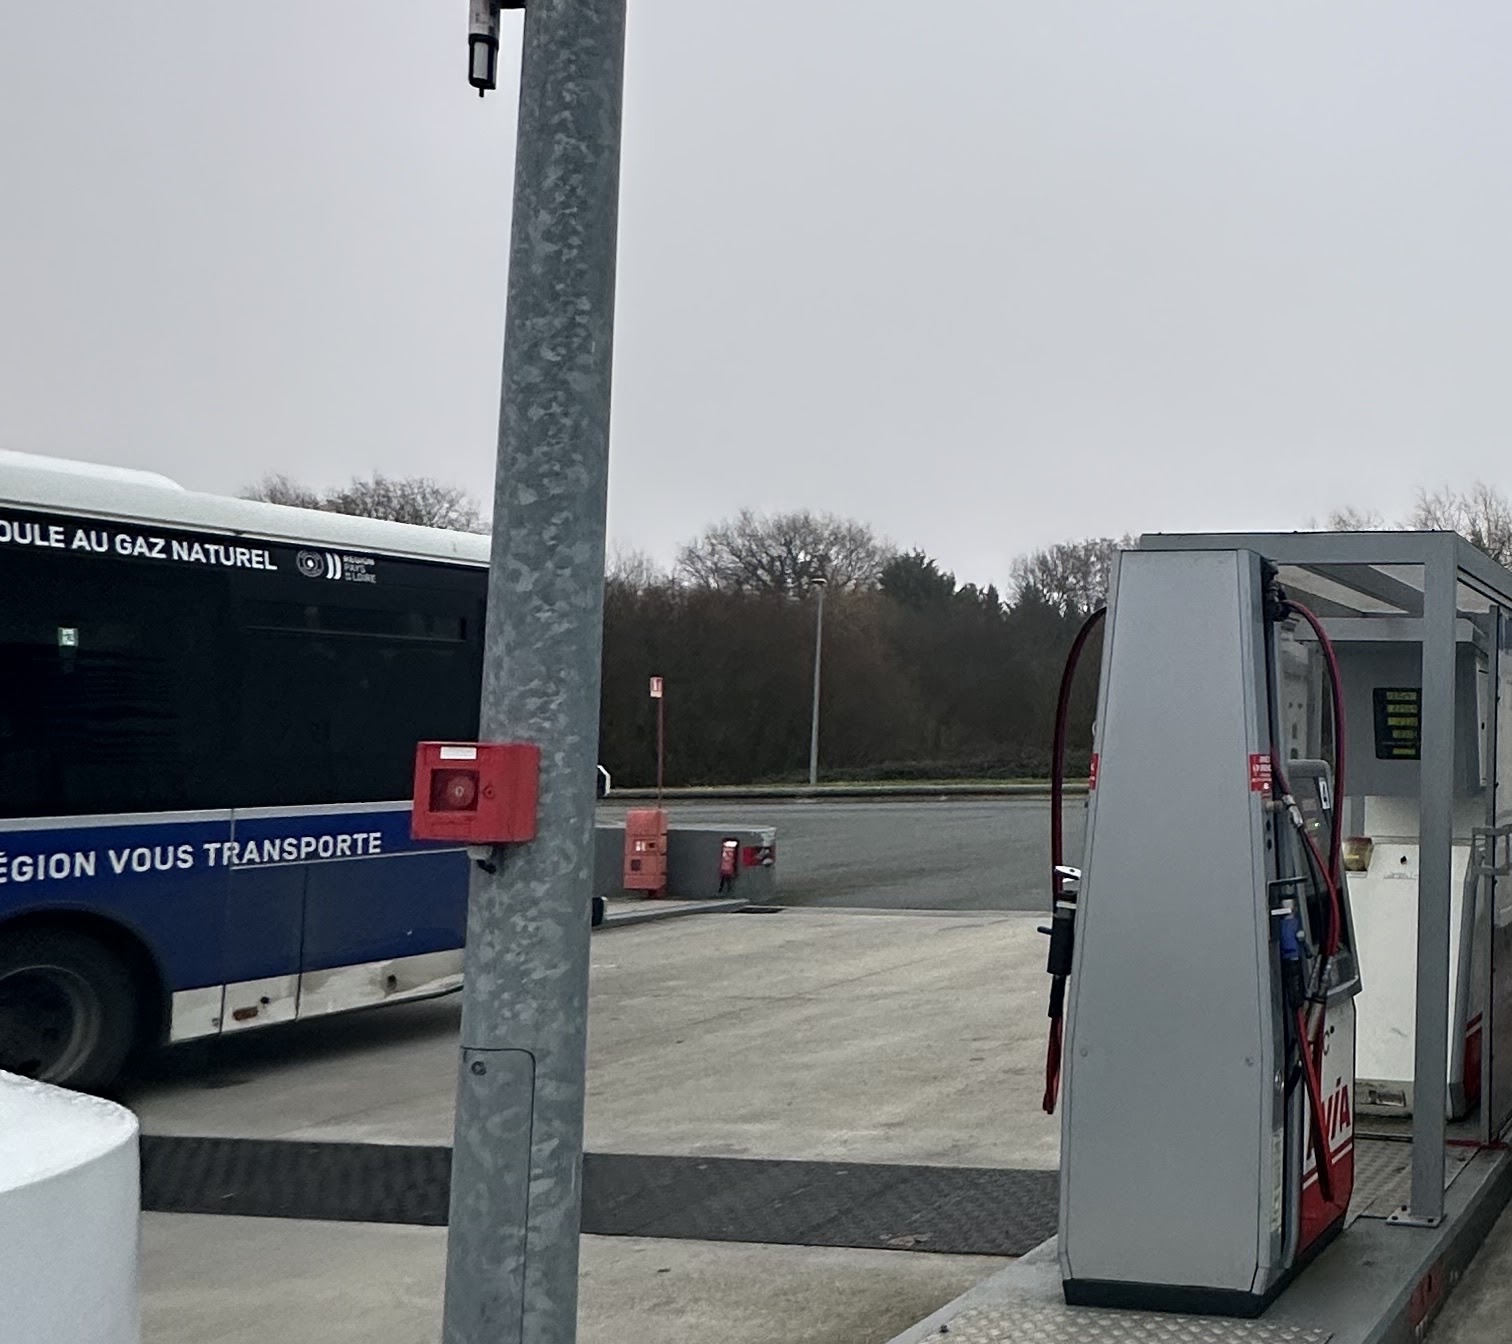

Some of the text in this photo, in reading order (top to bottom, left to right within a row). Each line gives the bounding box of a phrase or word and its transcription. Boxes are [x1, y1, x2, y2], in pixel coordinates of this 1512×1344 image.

[71, 529, 108, 553] AU
[115, 533, 167, 559] GAZ
[172, 540, 278, 571] NATUREL
[108, 844, 194, 874] VOUS
[203, 832, 382, 867] TRANSPORTE
